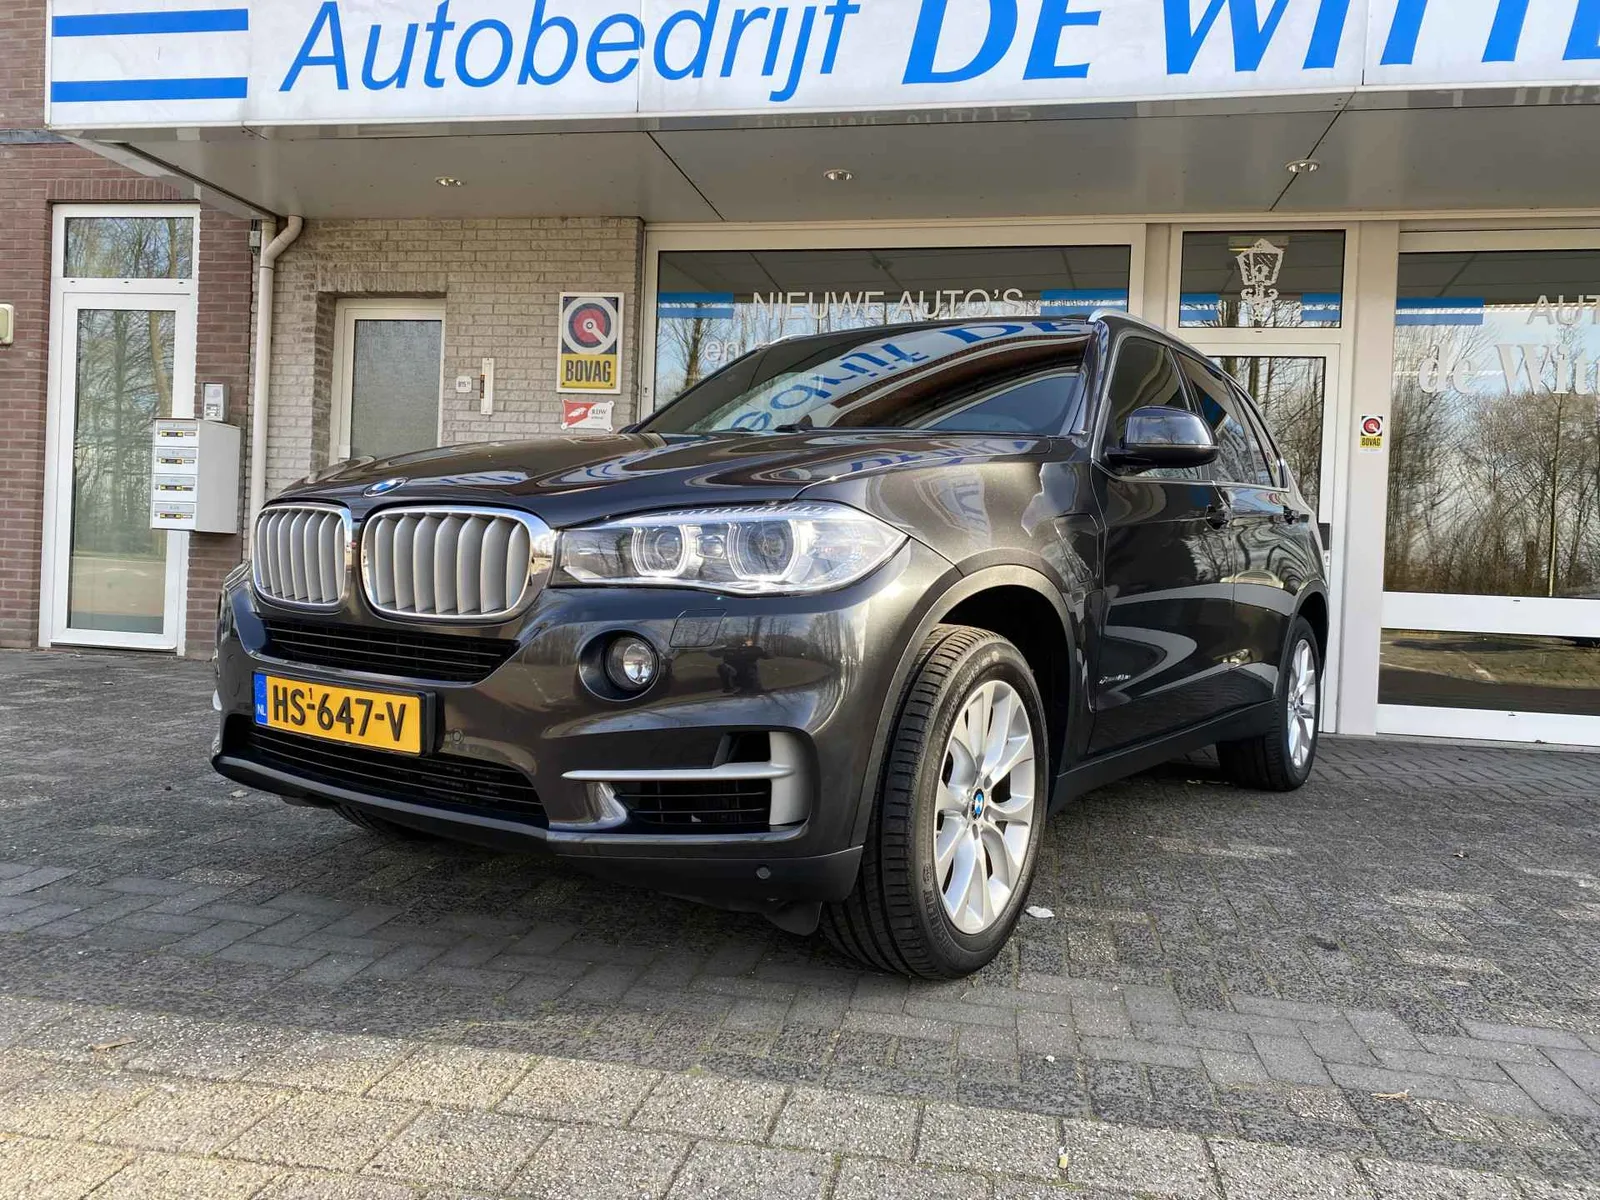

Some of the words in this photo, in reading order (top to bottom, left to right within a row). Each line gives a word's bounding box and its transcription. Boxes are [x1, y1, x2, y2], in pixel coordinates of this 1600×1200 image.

[279, 0, 861, 102] Autobedrijf
[752, 291, 885, 321] NIEUWE
[565, 359, 612, 383] BOVAG
[1418, 343, 1472, 394] de
[1493, 343, 1600, 395] Wit
[1361, 437, 1381, 447] BOVAG
[257, 704, 267, 717] NL
[272, 684, 407, 742] HS-647-V
